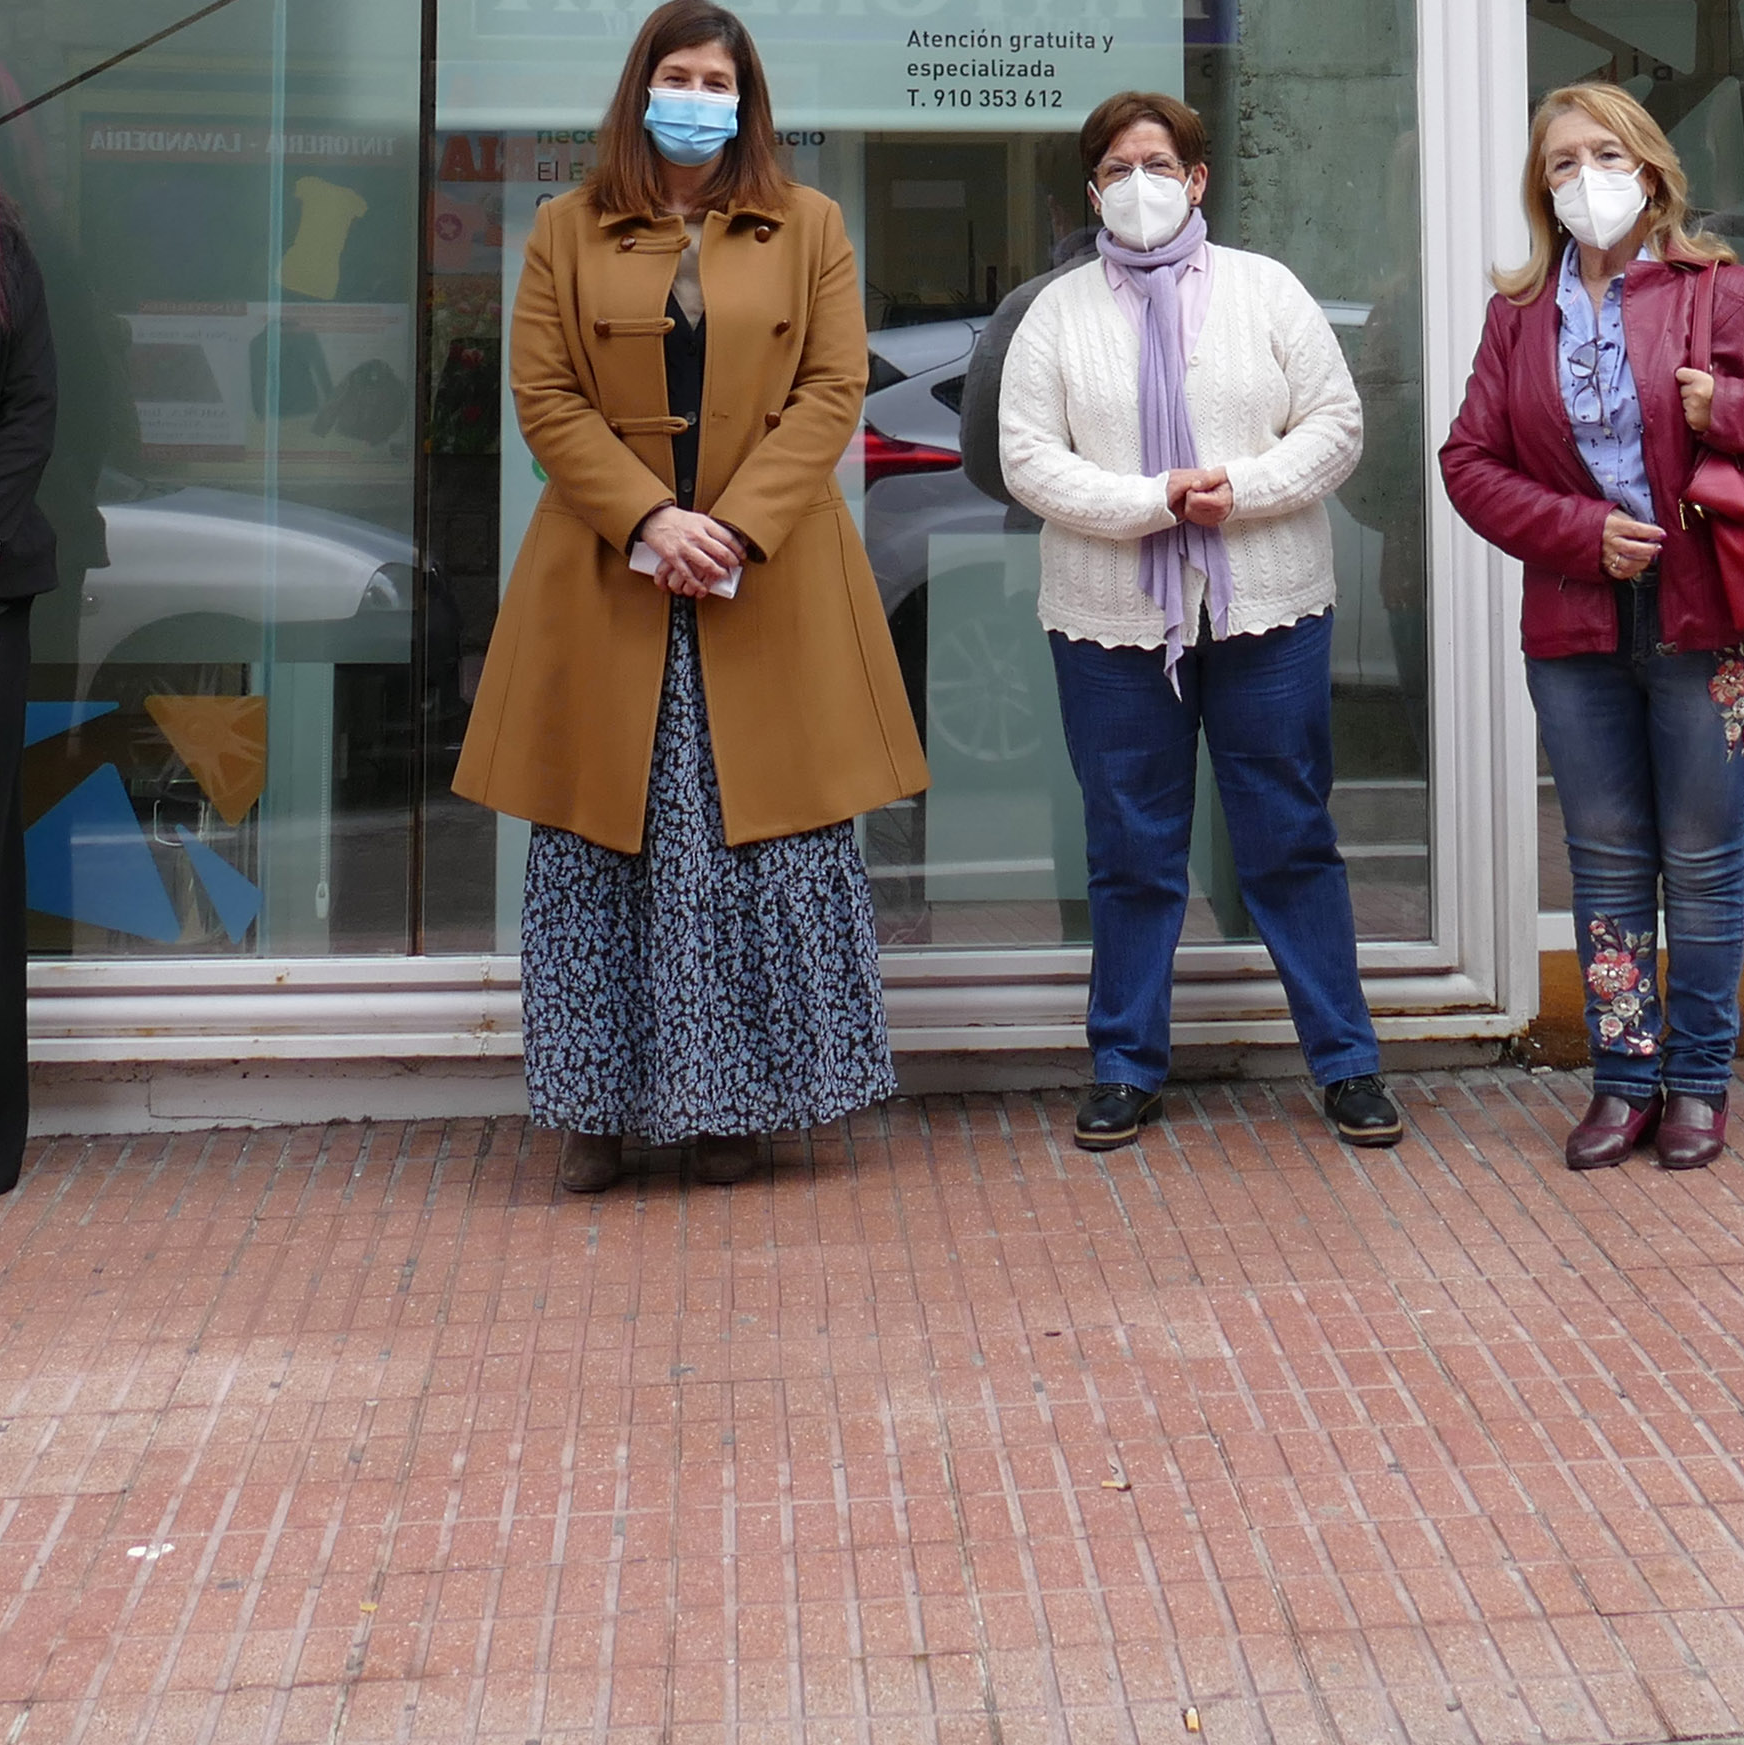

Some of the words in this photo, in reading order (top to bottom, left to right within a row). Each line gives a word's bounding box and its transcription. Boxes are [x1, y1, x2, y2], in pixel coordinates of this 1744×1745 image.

[907, 29, 1002, 48] Atención
[1009, 31, 1095, 53] gratuita
[1102, 35, 1114, 53] y
[907, 59, 1055, 80] especializada
[907, 89, 926, 107] T.
[934, 89, 972, 107] 910
[979, 90, 1017, 108] 353
[1024, 90, 1062, 108] 612
